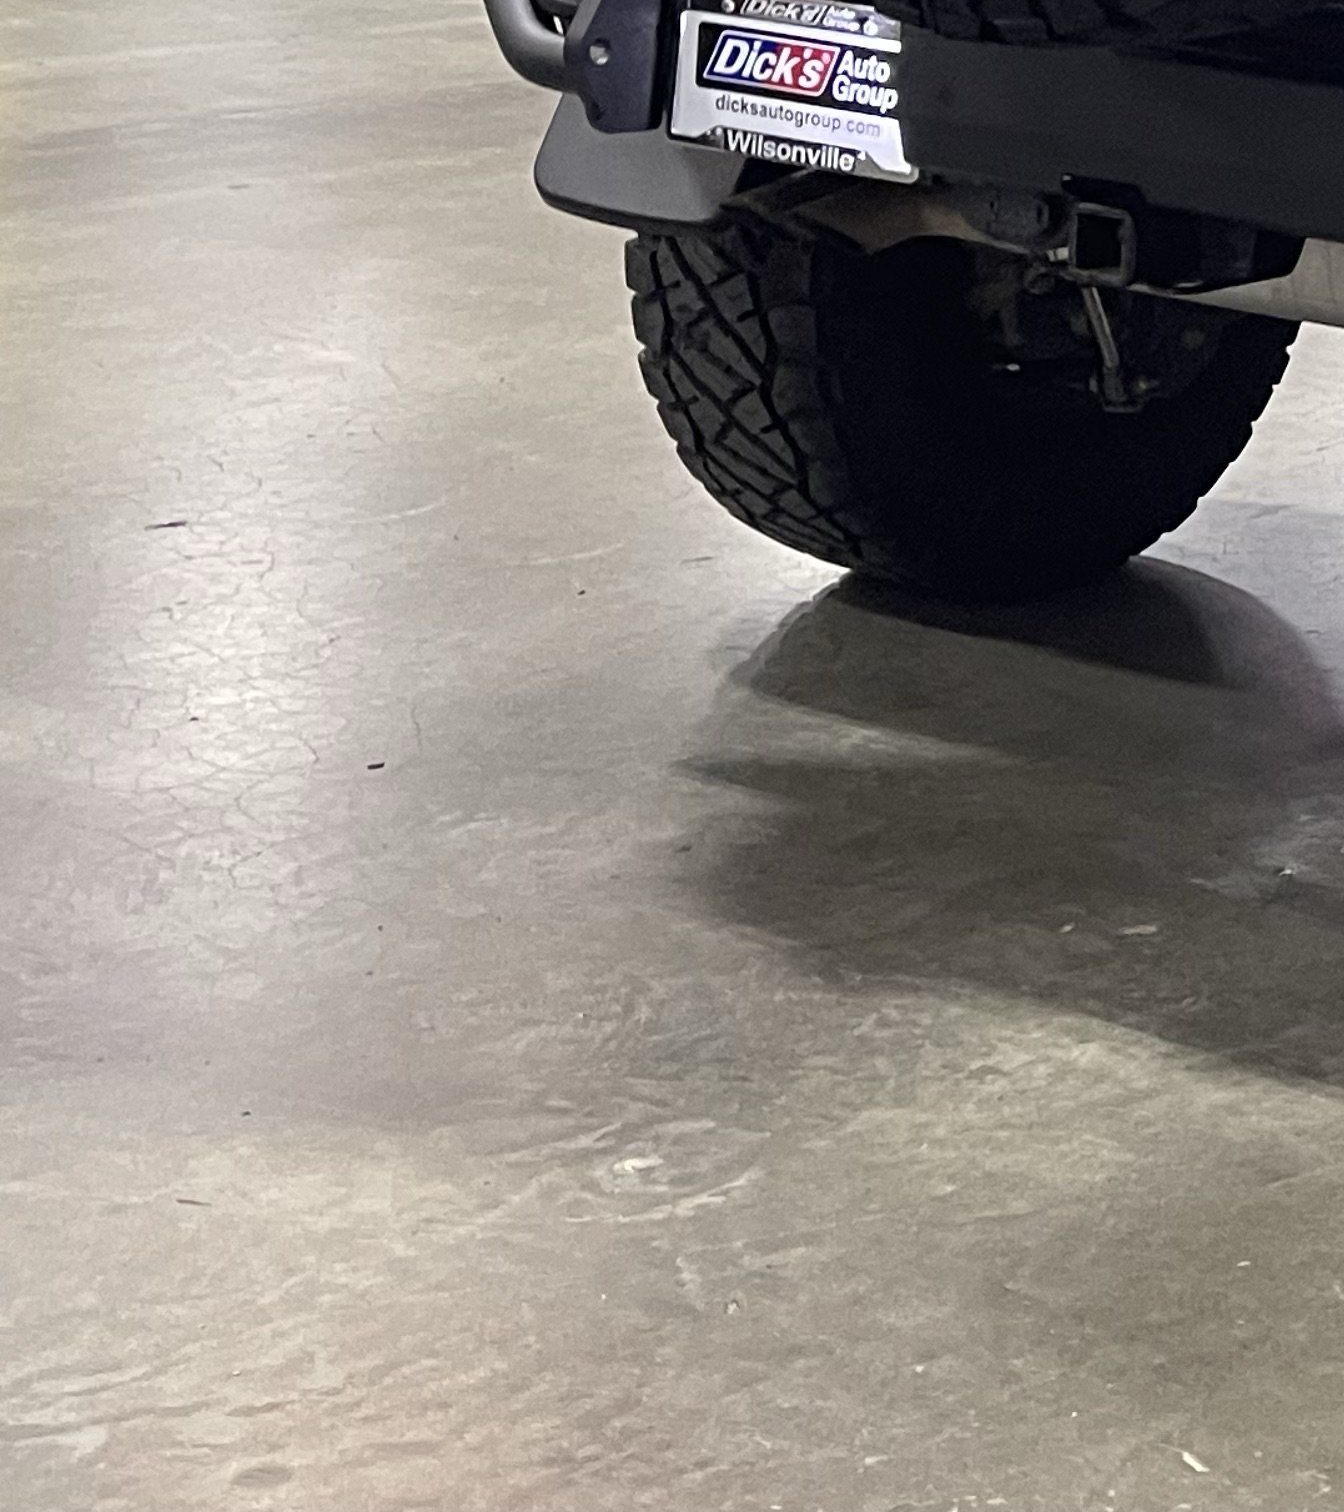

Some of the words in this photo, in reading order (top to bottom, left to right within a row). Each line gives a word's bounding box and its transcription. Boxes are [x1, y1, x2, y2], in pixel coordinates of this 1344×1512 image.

[713, 38, 827, 89] Dick's
[837, 50, 891, 83] Auto
[832, 74, 899, 113] Group
[726, 128, 856, 172] Wilsonville
